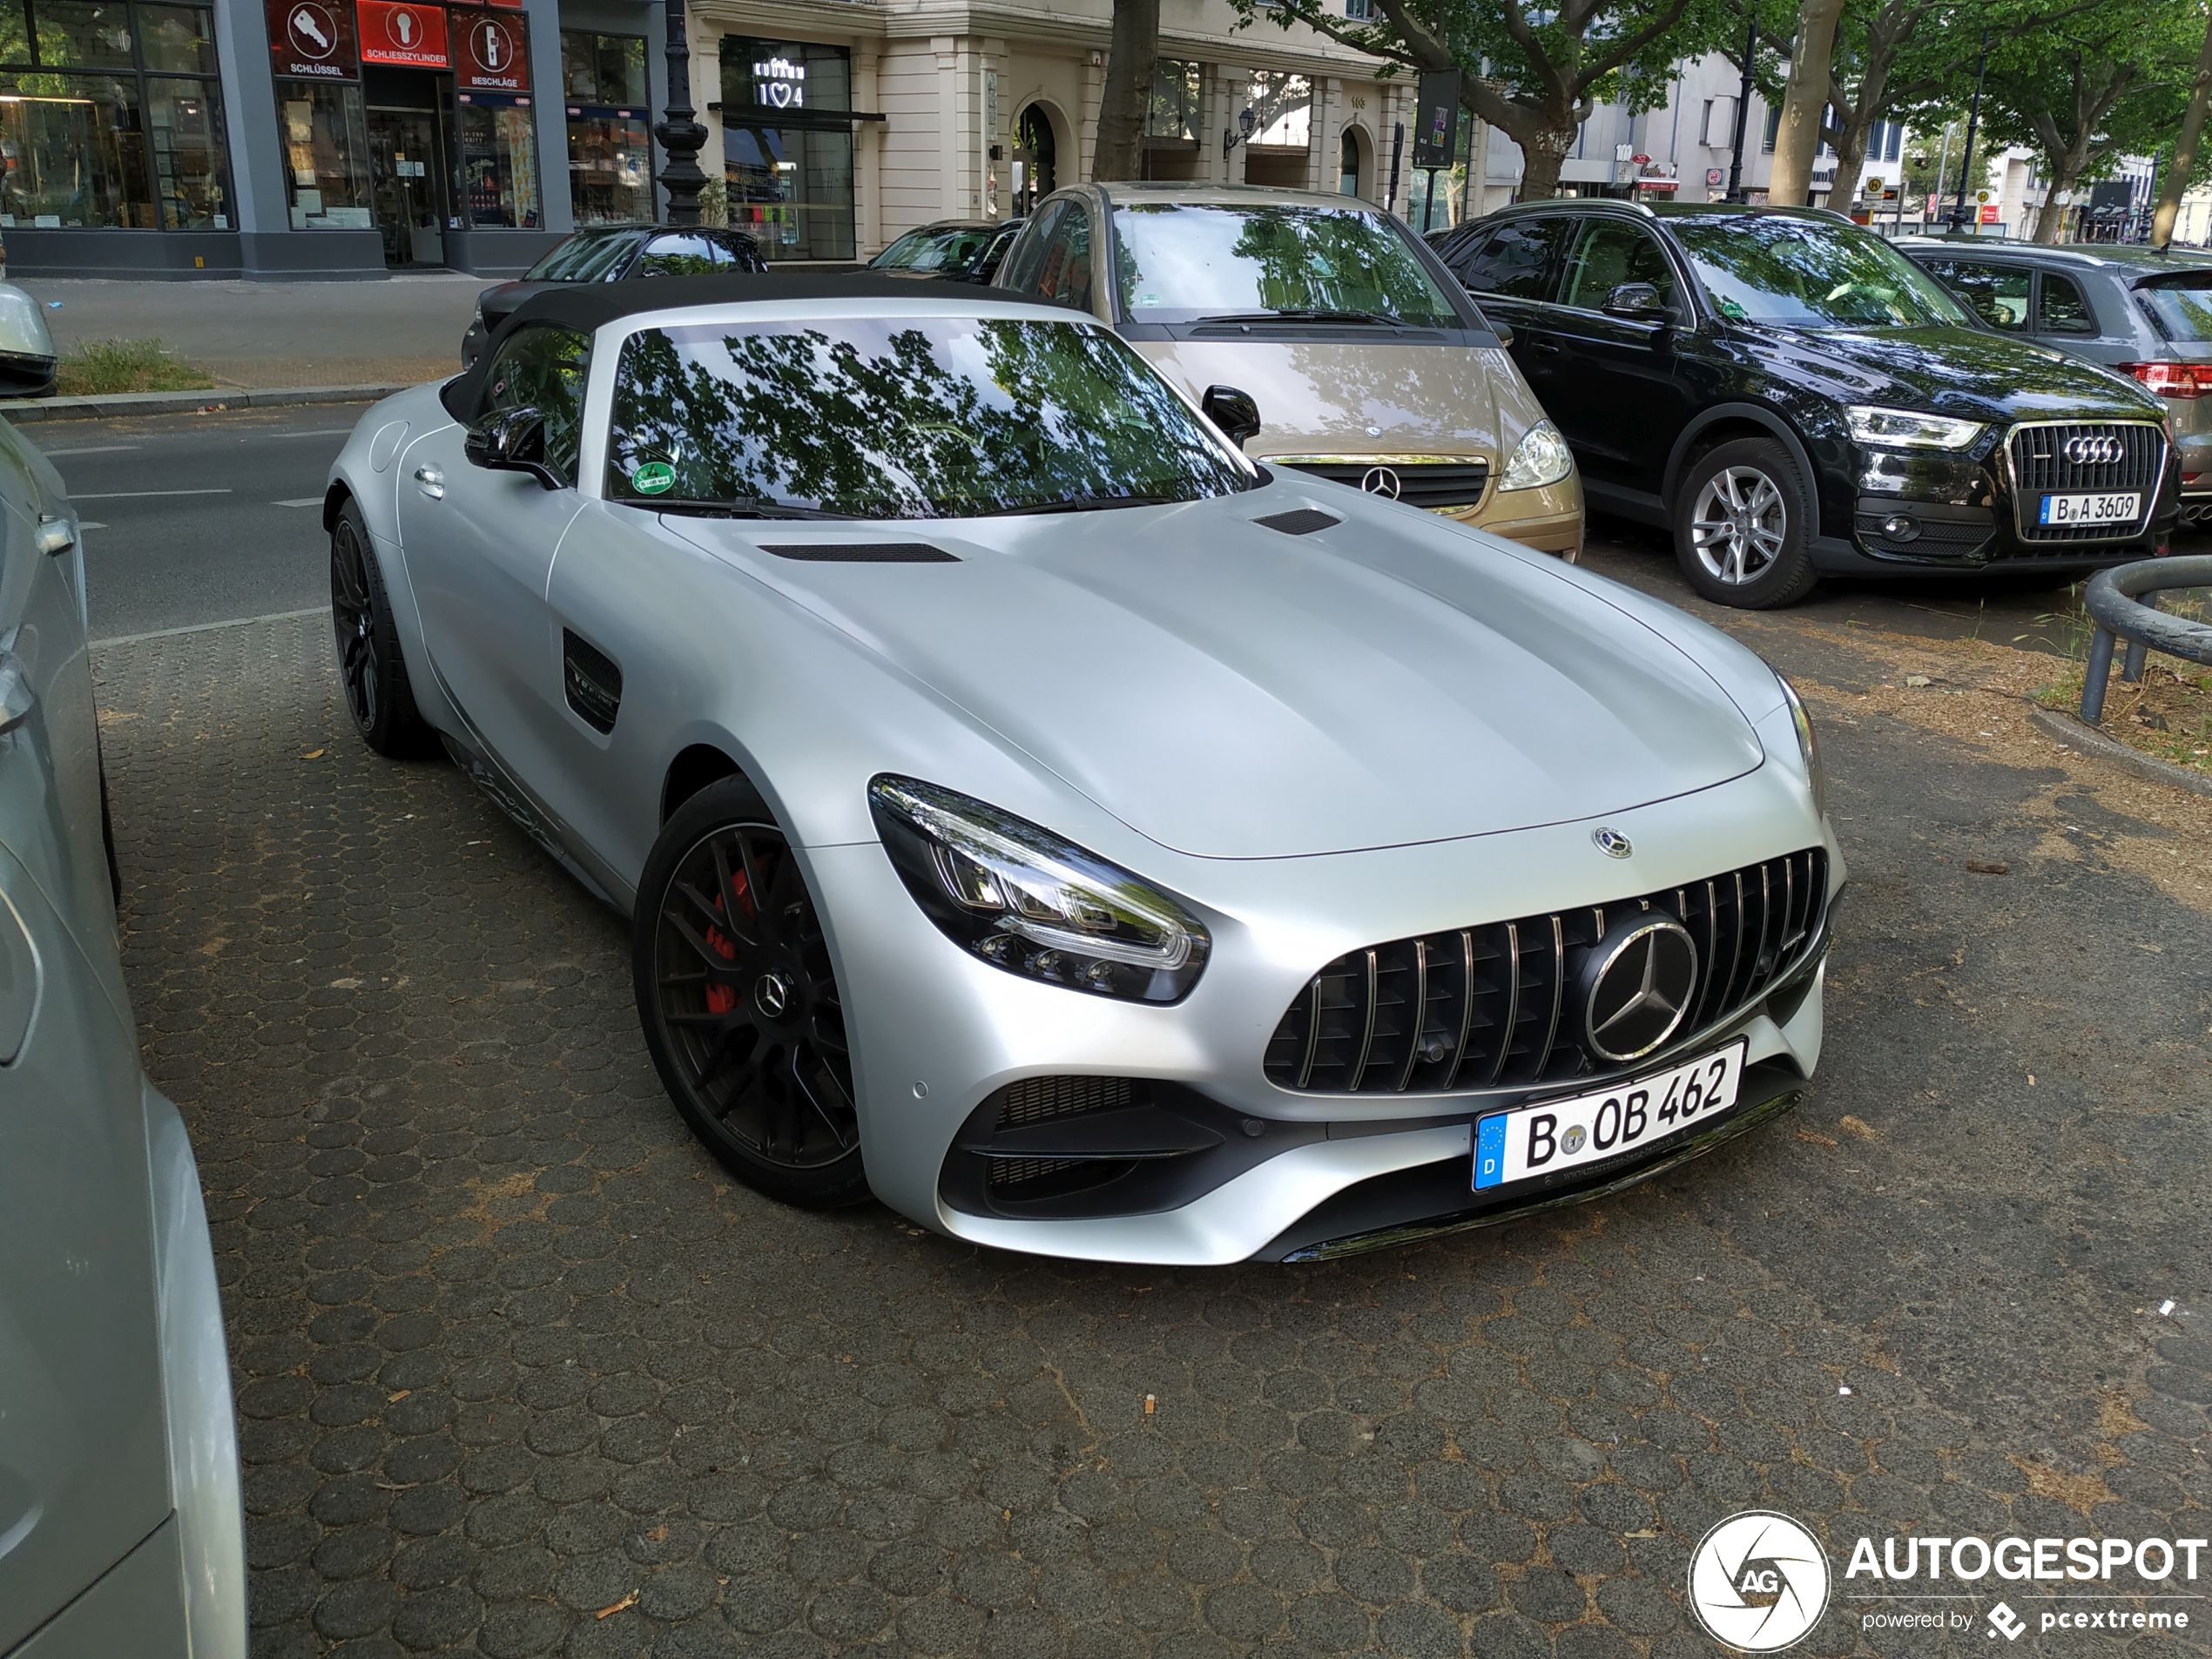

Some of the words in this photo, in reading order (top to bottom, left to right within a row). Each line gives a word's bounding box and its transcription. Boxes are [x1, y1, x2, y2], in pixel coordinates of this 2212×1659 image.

[367, 49, 447, 64] SCHLIESSZYLINDER
[290, 63, 343, 77] SCHLÜSSEL
[471, 76, 518, 88] BESCHLÄGE
[2059, 499, 2068, 520] B
[2080, 498, 2090, 520] A
[2095, 496, 2134, 517] 3609
[1527, 1114, 1557, 1169] B
[1593, 1089, 1649, 1151] OB
[1656, 1057, 1727, 1125] 462
[1484, 1159, 1495, 1175] D
